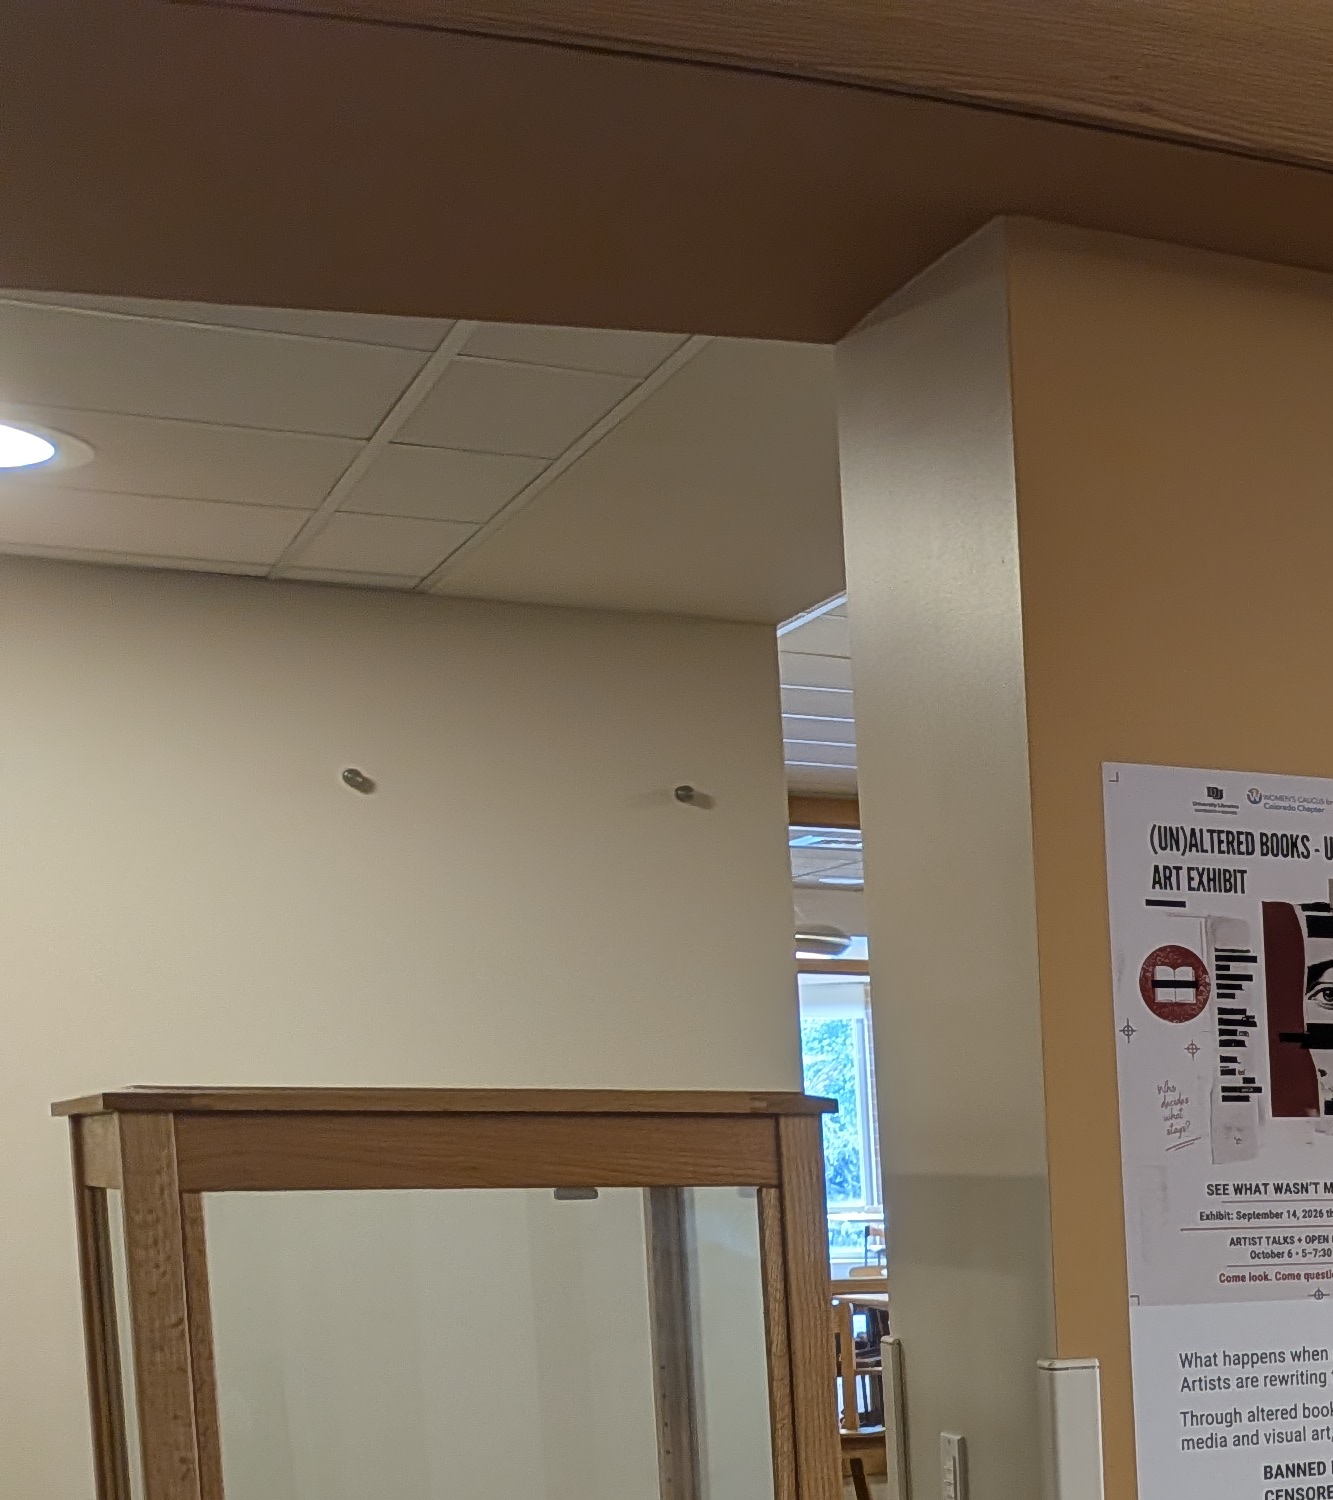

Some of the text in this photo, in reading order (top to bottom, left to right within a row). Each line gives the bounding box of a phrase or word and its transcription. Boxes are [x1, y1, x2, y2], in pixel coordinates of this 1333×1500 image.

[1150, 824, 1254, 856] (UN)ALTERED
[1260, 832, 1311, 859] BOOKS
[1152, 865, 1247, 894] ART EXHIBIT
[1164, 1107, 1183, 1122] what
[1167, 1120, 1191, 1139] stays?
[1207, 1184, 1230, 1195] SEE
[1233, 1183, 1269, 1195] WHAT
[1273, 1181, 1320, 1194] WASN'T
[1199, 1210, 1234, 1221] Exhibit:
[1236, 1210, 1283, 1222] September
[1286, 1210, 1300, 1220] 14,
[1302, 1209, 1324, 1219] 2026
[1229, 1236, 1263, 1247] ARTIST
[1265, 1235, 1295, 1246] TALKS
[1305, 1234, 1329, 1244] OPEN
[1250, 1249, 1284, 1260] October
[1287, 1248, 1293, 1258] 6
[1219, 1272, 1246, 1284] Come
[1248, 1271, 1272, 1282] look.
[1275, 1271, 1301, 1282] Come
[1179, 1352, 1218, 1369] What
[1222, 1348, 1286, 1370] happens
[1289, 1347, 1329, 1363] when
[1180, 1375, 1231, 1393] Artists
[1235, 1375, 1259, 1390] are
[1263, 1368, 1327, 1390] rewriting
[1180, 1406, 1242, 1428] Through
[1247, 1404, 1298, 1423] altered
[1181, 1434, 1228, 1451] media
[1232, 1431, 1260, 1448] and
[1263, 1427, 1307, 1446] visual
[1263, 1462, 1327, 1480] BANNED
